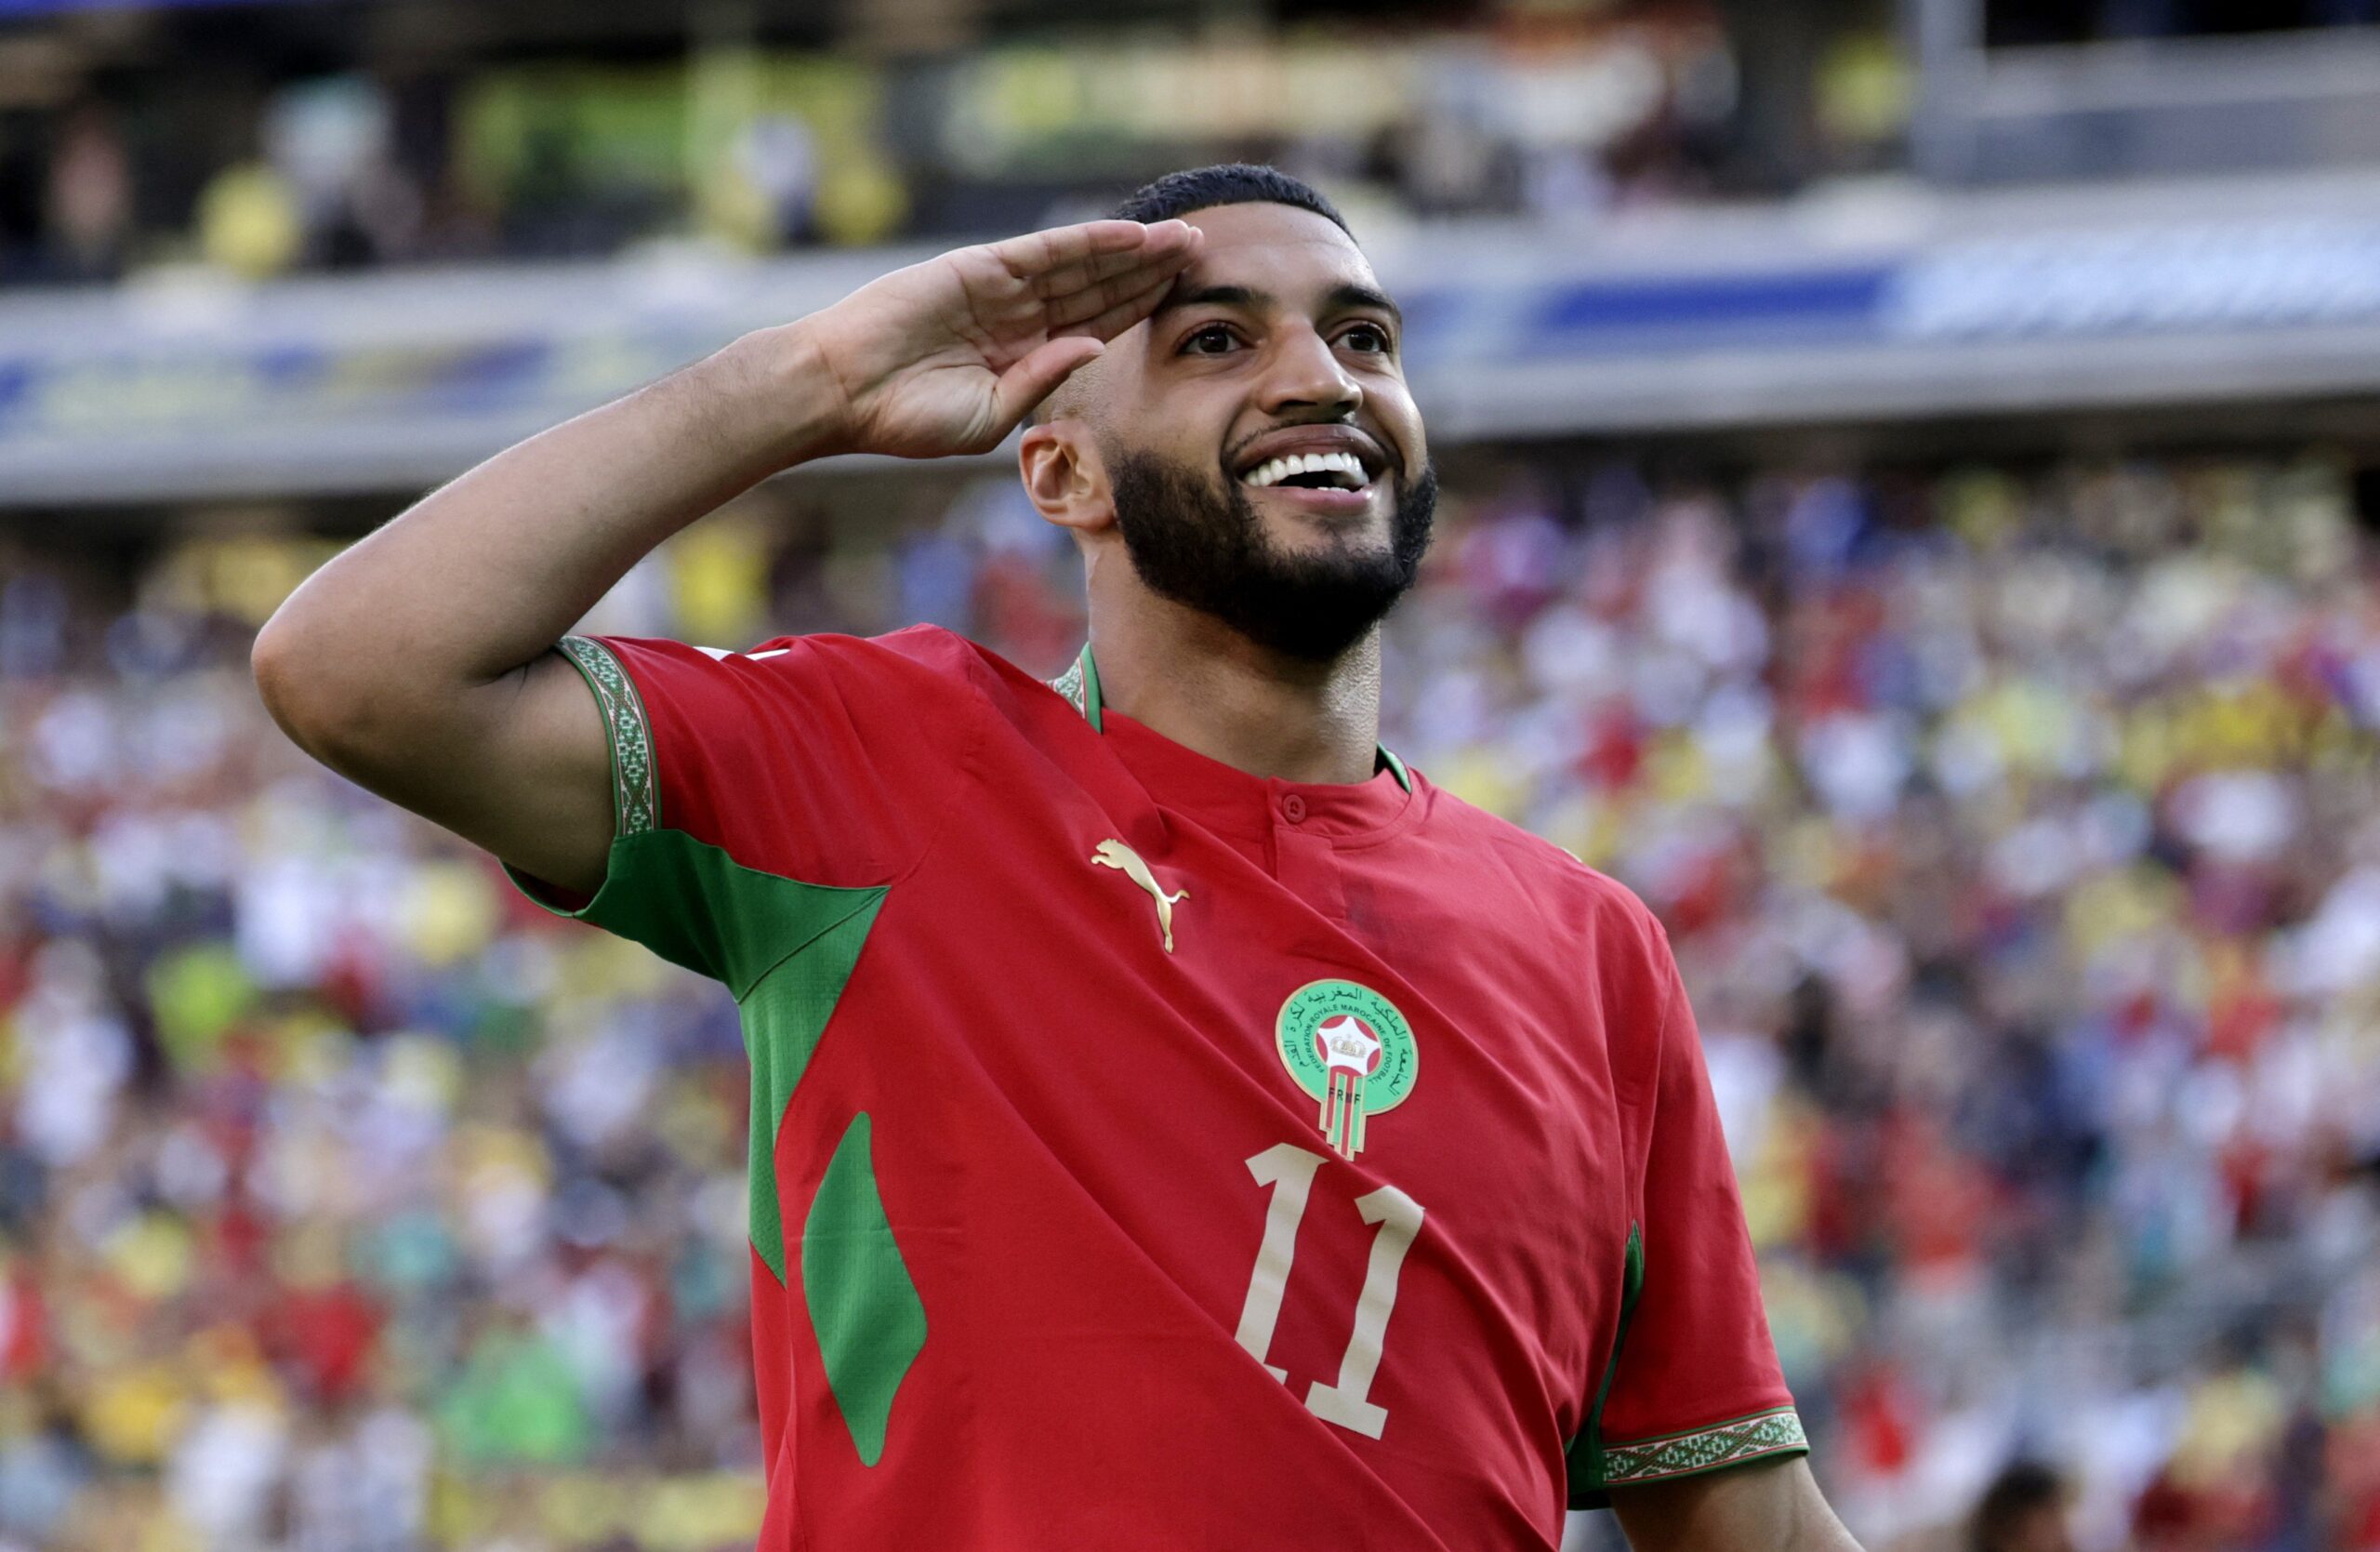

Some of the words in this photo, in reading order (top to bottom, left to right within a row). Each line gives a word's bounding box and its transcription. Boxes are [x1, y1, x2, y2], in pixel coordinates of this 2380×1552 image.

[1303, 988, 1362, 1004] المغربية
[1286, 1002, 1305, 1032] لكرة
[1309, 1004, 1339, 1023] ROYALE
[1341, 1003, 1386, 1036] MAROCAINE
[1370, 996, 1408, 1040] الملكية
[1284, 1040, 1309, 1067] القدم
[1382, 1038, 1393, 1049] DE
[1368, 1051, 1393, 1085] FOOTBALL
[1388, 1048, 1413, 1096] الجامعة
[1234, 1142, 1426, 1440] 11
